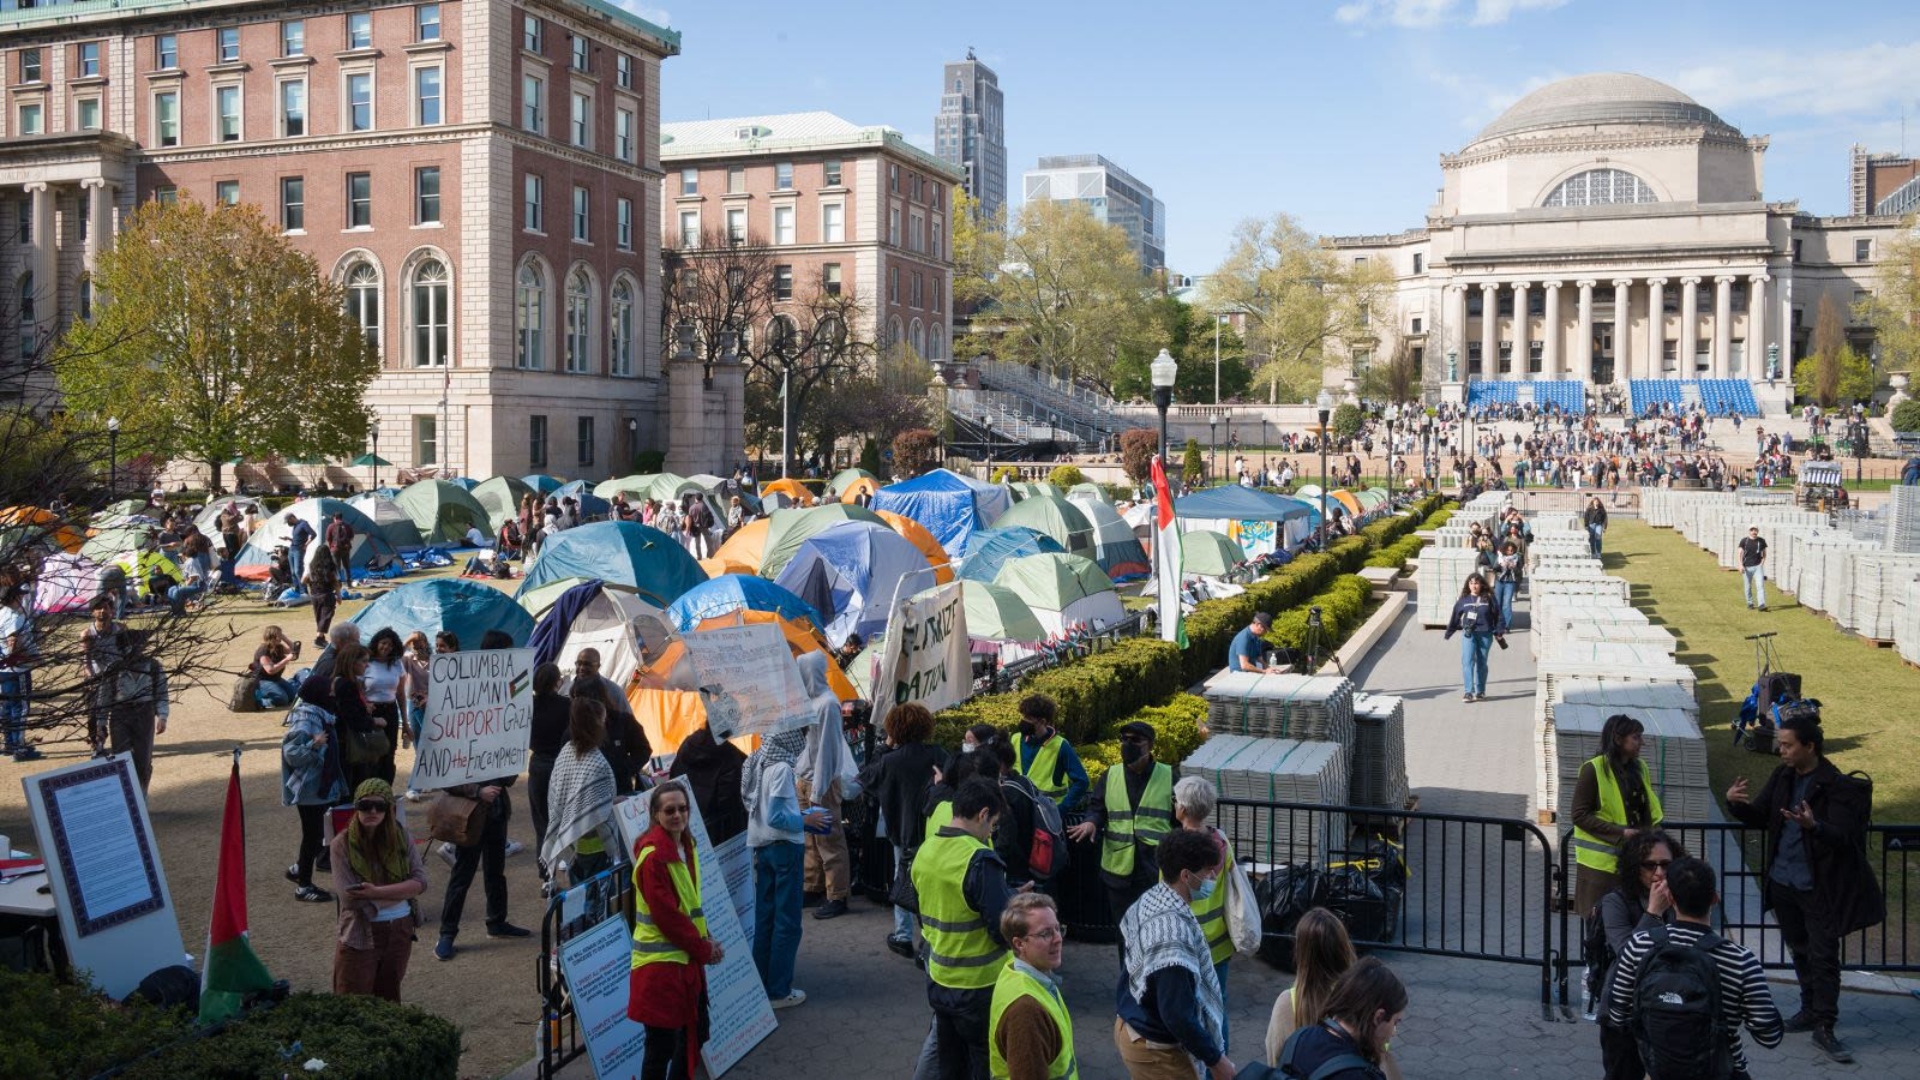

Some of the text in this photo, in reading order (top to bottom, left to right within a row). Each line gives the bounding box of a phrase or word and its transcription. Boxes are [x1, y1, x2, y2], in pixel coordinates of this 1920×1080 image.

[432, 653, 515, 683] COLUMBIA
[441, 681, 508, 711] ALUMNI
[428, 707, 504, 741] SUPPORT
[416, 748, 452, 777] AND
[451, 749, 467, 769] the
